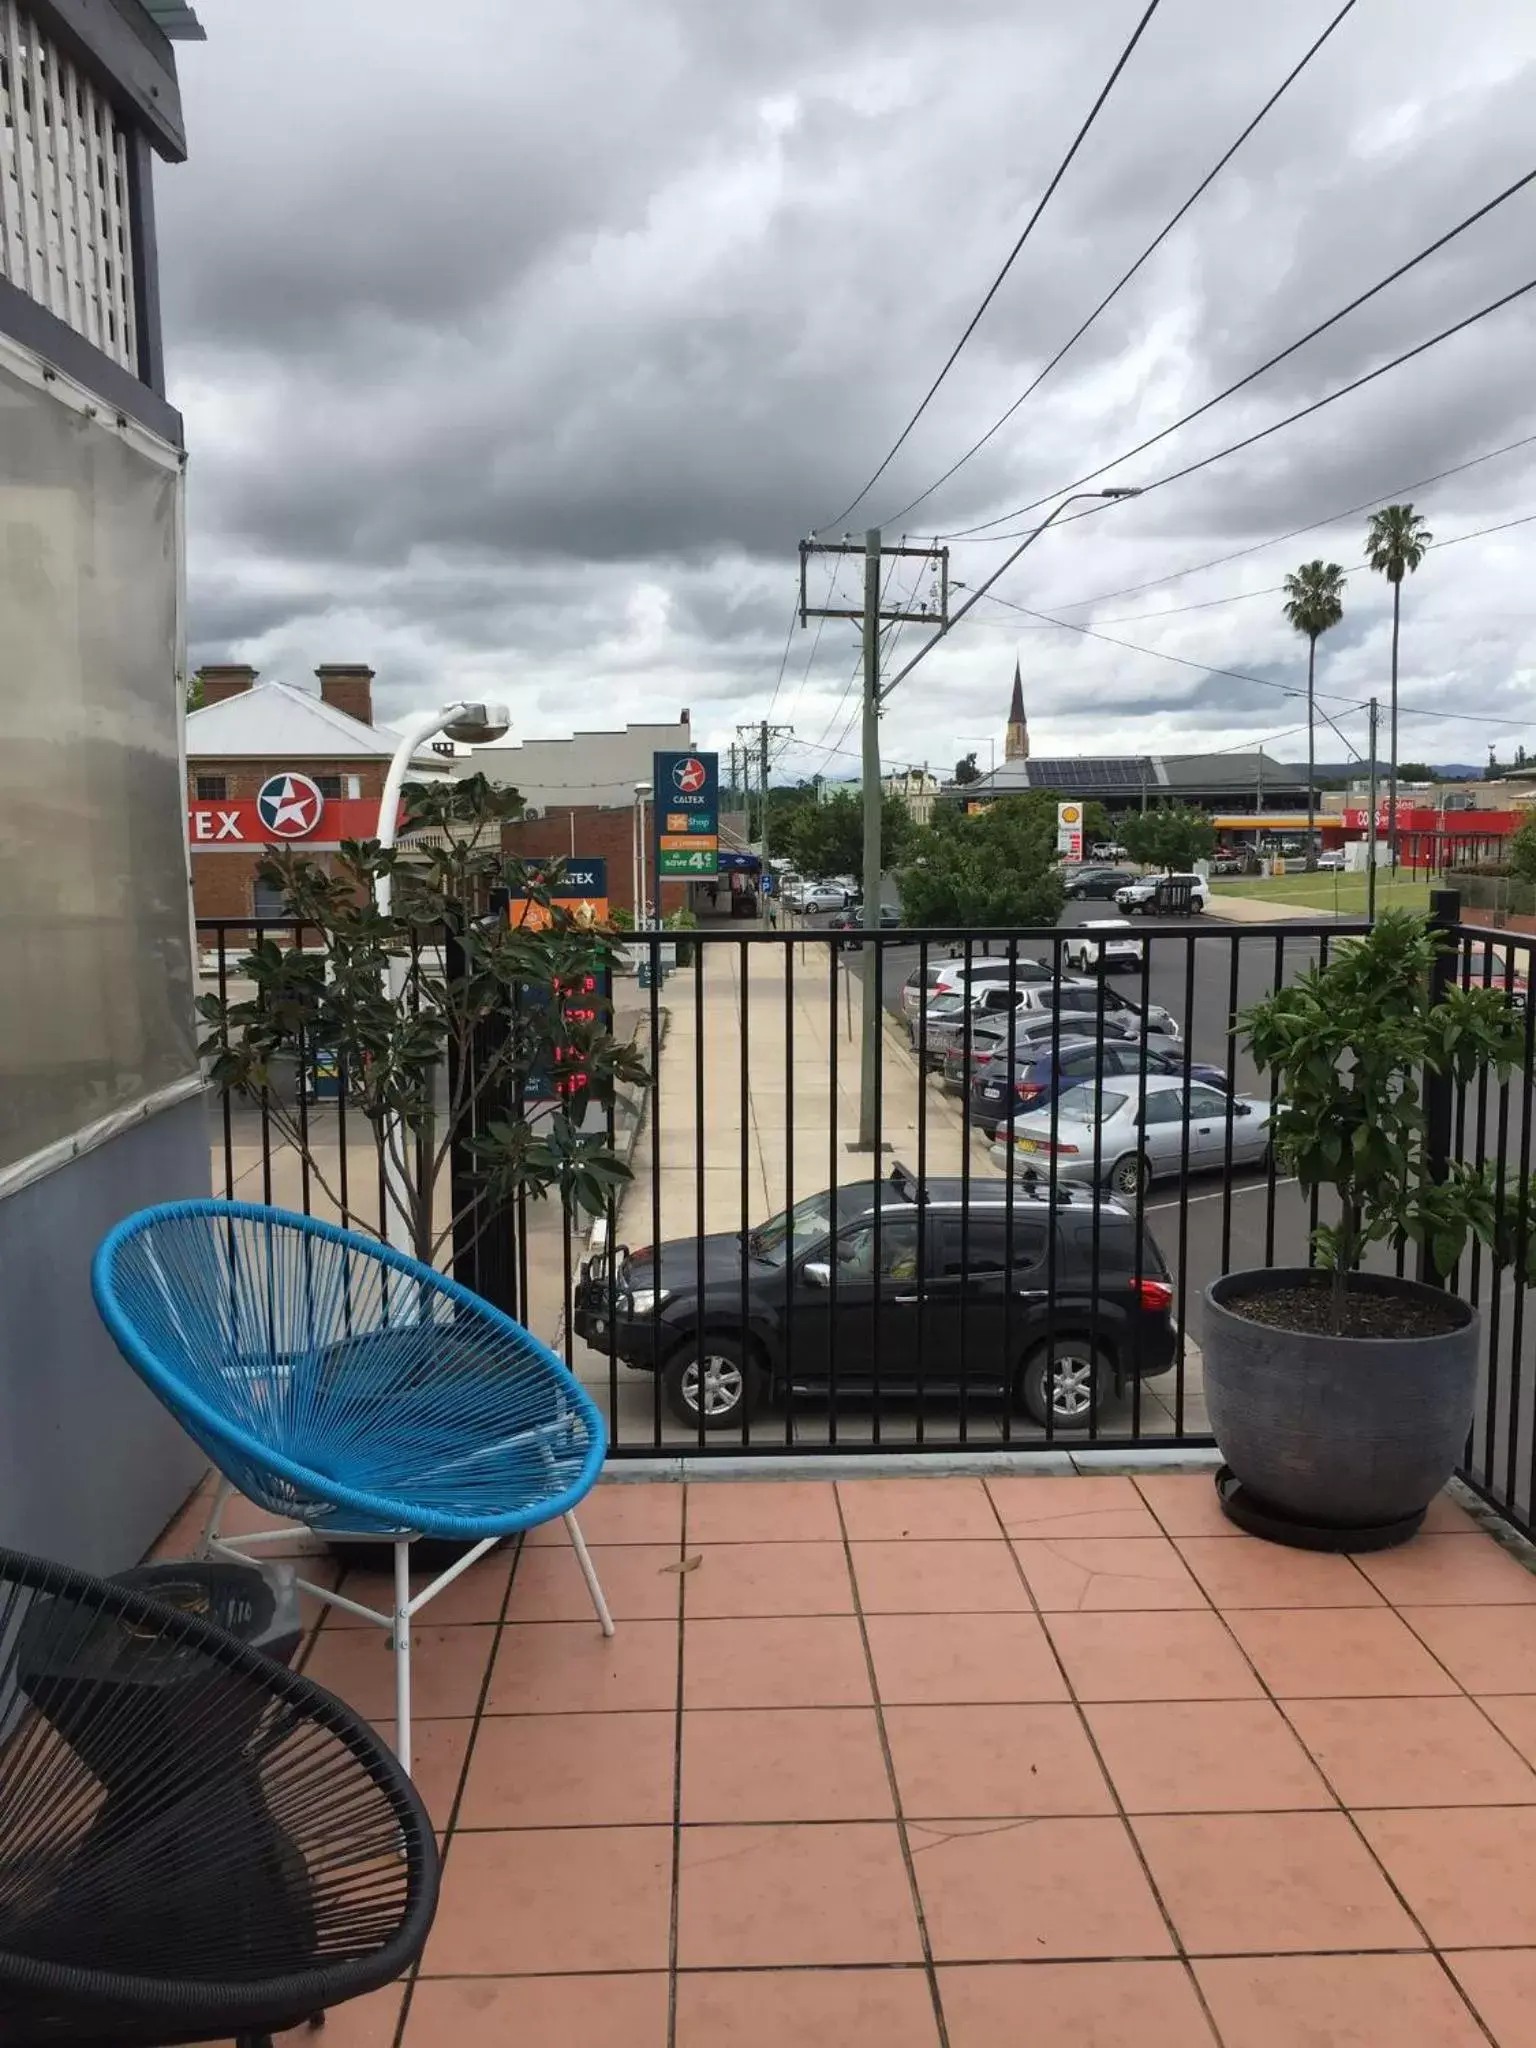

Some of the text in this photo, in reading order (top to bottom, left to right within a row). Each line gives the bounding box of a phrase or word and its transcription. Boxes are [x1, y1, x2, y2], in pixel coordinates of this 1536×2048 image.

[673, 795, 705, 804] CALTEX
[188, 811, 244, 839] EX
[1357, 810, 1381, 826] COS
